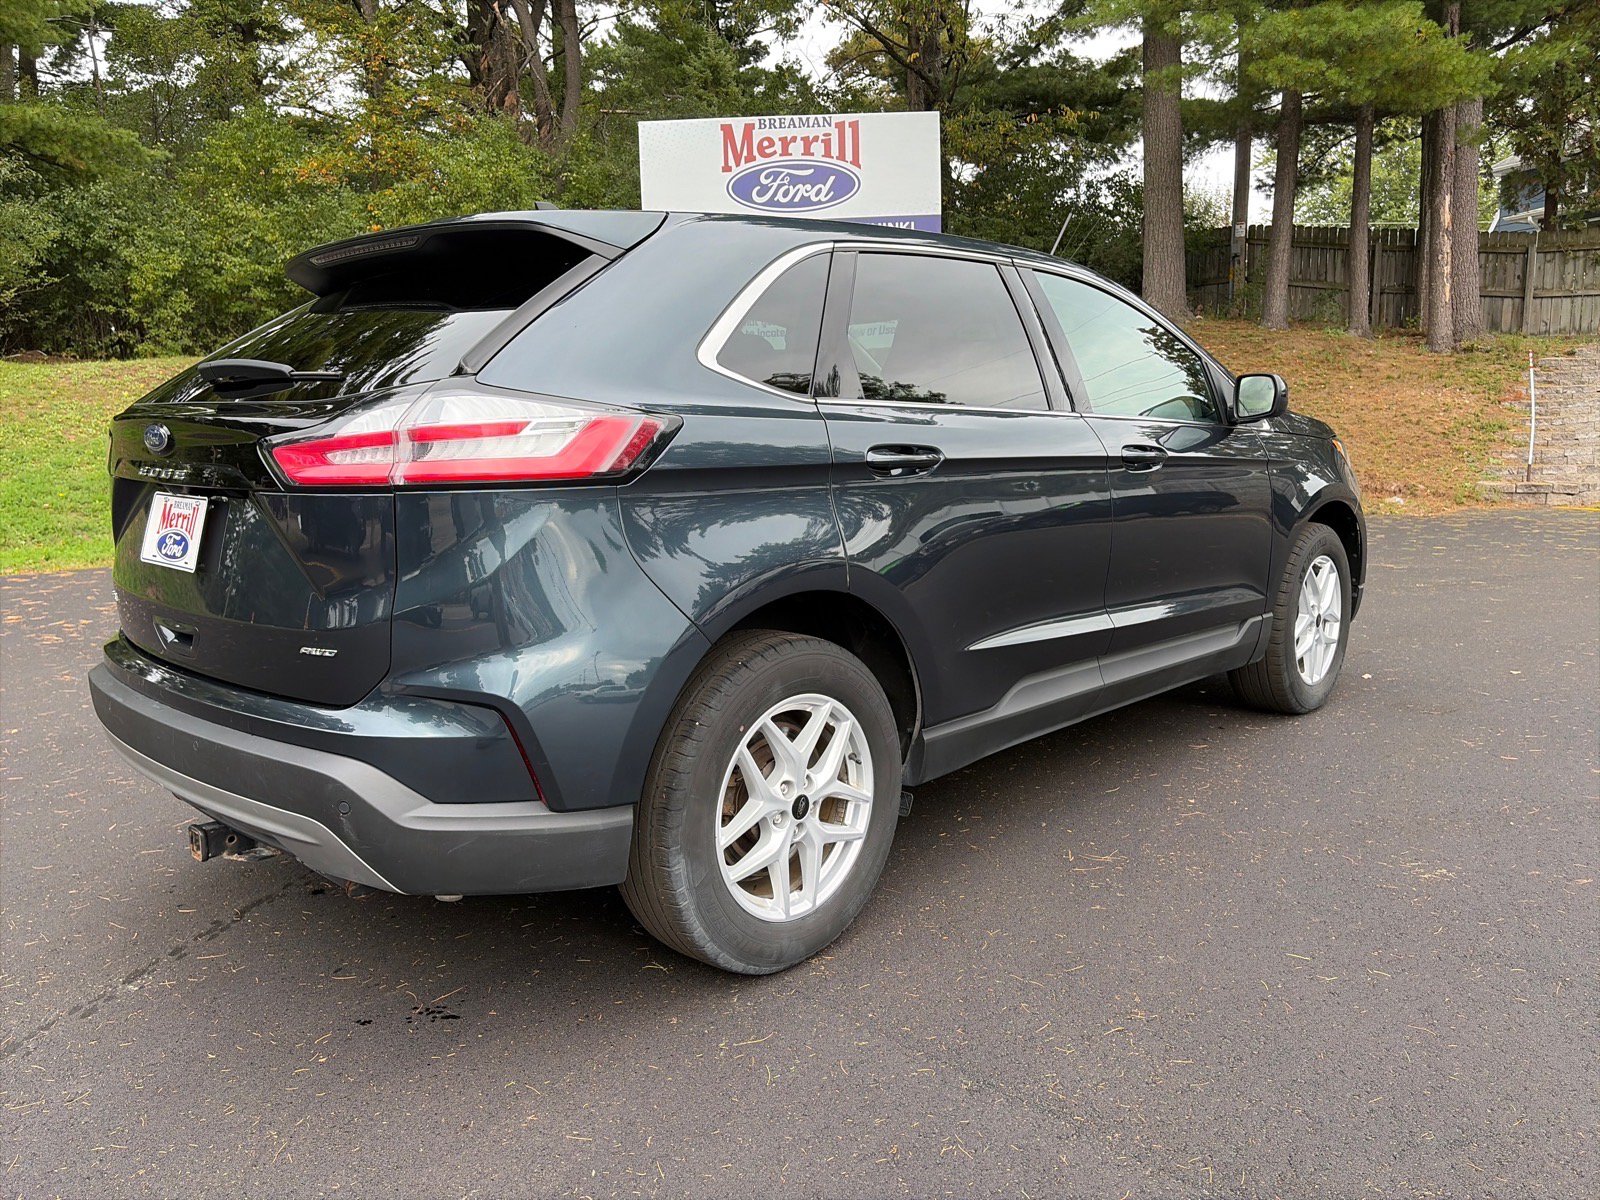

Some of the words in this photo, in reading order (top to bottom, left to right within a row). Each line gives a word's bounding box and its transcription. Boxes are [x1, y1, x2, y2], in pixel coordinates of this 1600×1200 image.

[758, 115, 832, 130] BREAMAN
[720, 119, 862, 173] Merrill
[752, 167, 836, 204] Ford
[157, 502, 199, 541] Merrill
[161, 533, 186, 558] Ford
